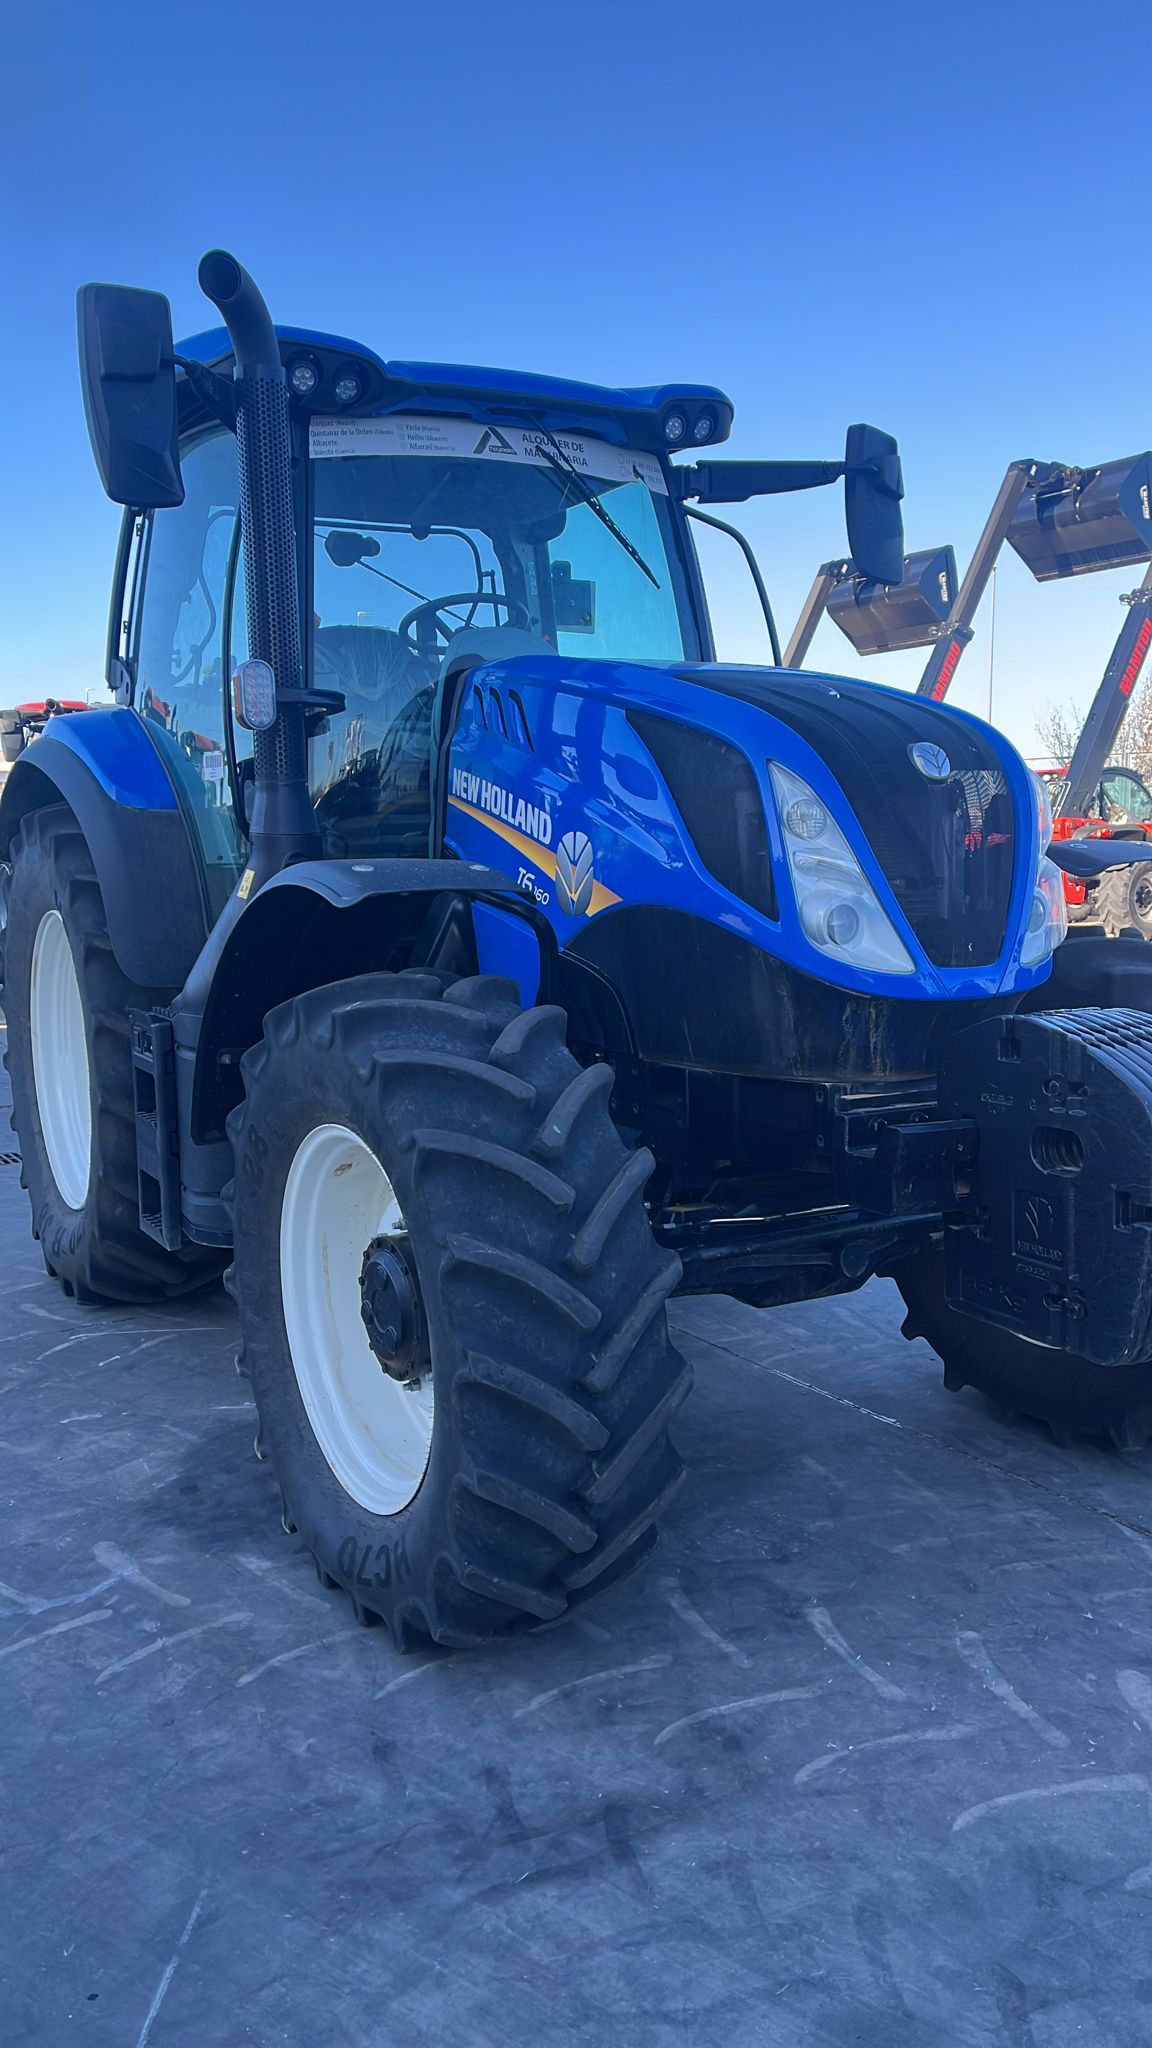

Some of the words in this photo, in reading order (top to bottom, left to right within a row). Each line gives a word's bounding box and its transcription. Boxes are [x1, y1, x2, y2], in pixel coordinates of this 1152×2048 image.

[522, 433, 570, 450] ALQUER
[571, 442, 584, 453] DE
[452, 767, 480, 804] NEW
[480, 779, 552, 845] HOLLAND
